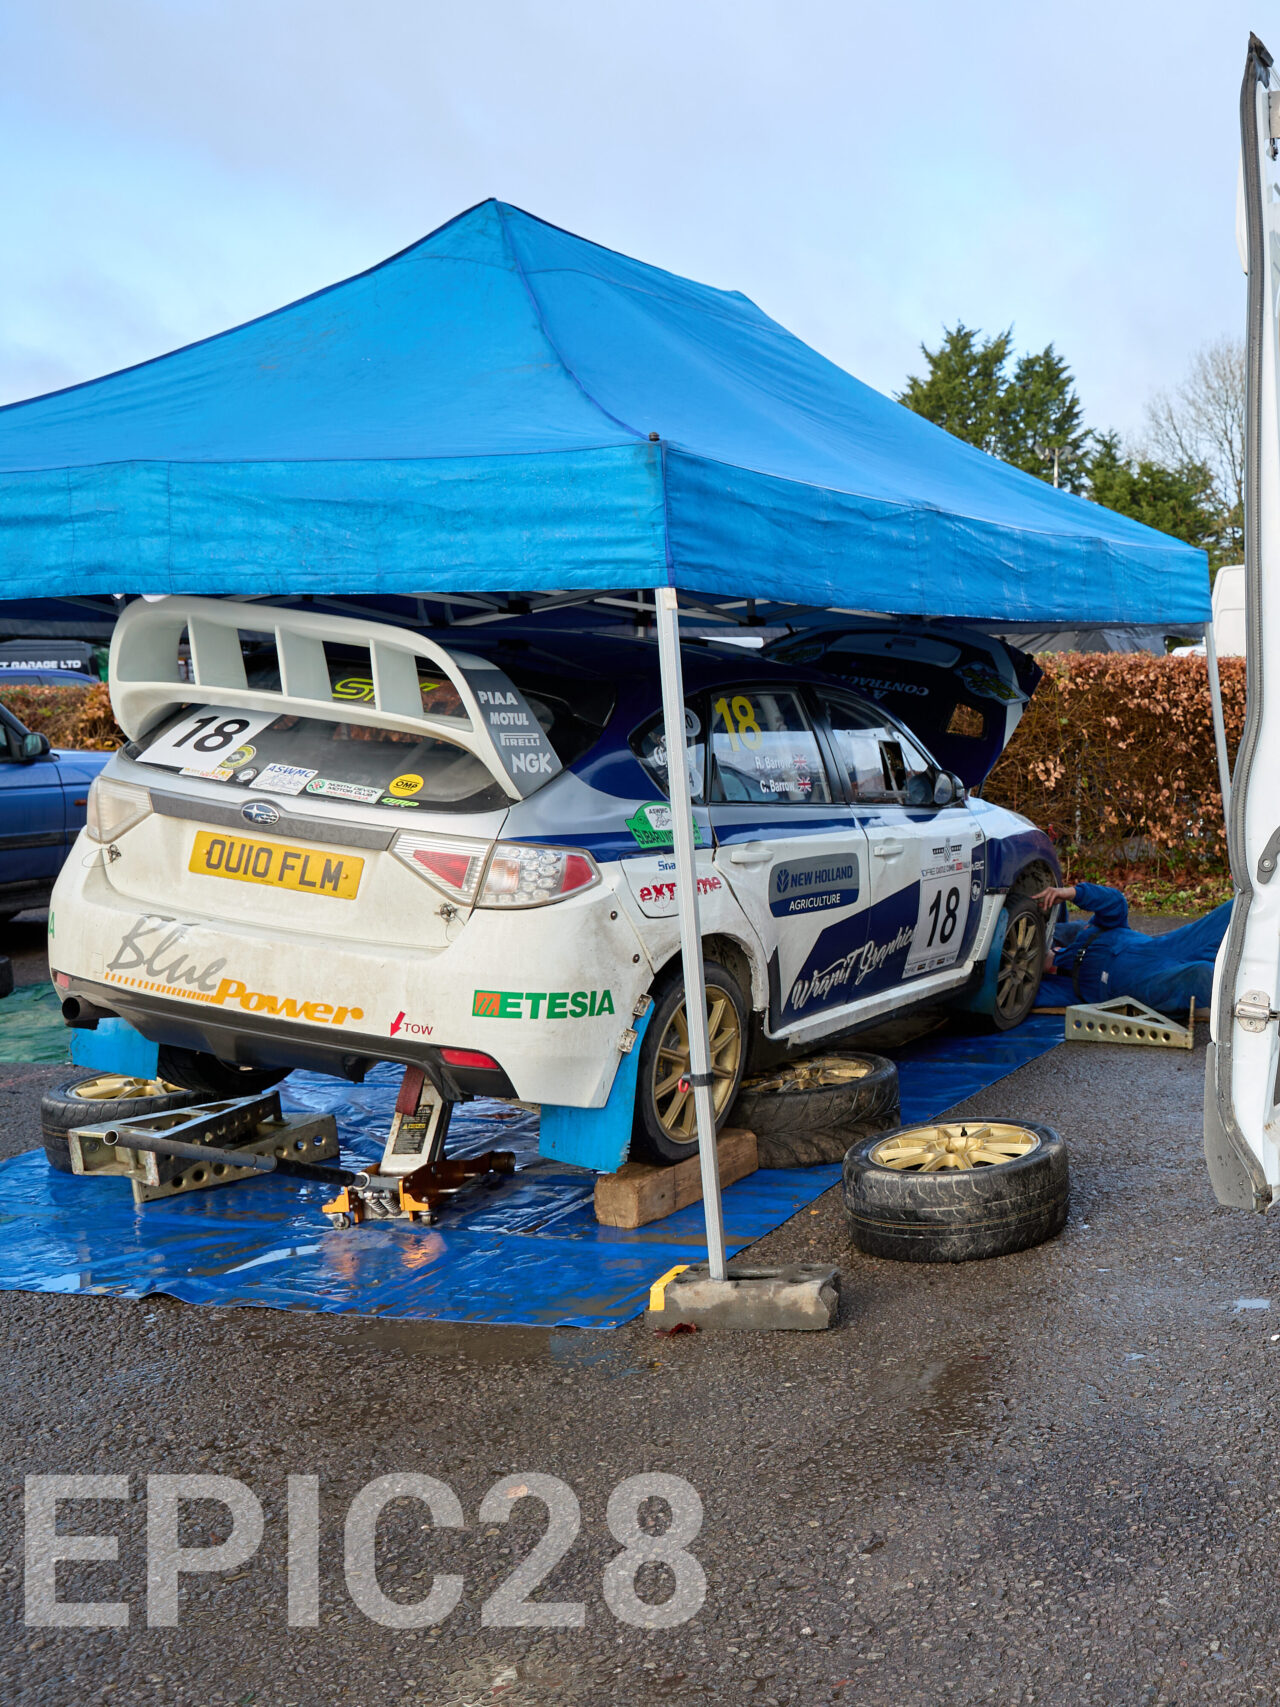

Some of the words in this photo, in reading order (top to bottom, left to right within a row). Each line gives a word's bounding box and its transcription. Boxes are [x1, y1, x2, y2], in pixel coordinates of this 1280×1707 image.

[10, 661, 58, 669] GARAGE
[60, 660, 82, 669] LTD
[477, 690, 519, 705] PIAA
[489, 711, 529, 726] MOTUL
[714, 696, 763, 752] 18
[172, 715, 250, 752] 18
[500, 733, 540, 746] PIRELLI
[267, 764, 315, 778] ASWMC
[511, 753, 552, 774] NGK
[326, 781, 351, 791] NORTH
[353, 786, 379, 795] DEVON
[326, 786, 352, 795] MOTOR
[354, 790, 374, 798] CLUB
[394, 780, 419, 790] OMP
[760, 779, 769, 793] C.
[770, 778, 796, 793] Barrow
[205, 838, 273, 879] OU10
[277, 851, 344, 892] FLM
[790, 871, 814, 888] NEW
[814, 865, 853, 884] HOLLAND
[789, 893, 841, 912] AGRICULTURE
[926, 886, 960, 948] 18
[106, 913, 228, 992] Blue
[211, 977, 364, 1025] Power
[500, 989, 616, 1020] ETESIA
[404, 1022, 434, 1036] TOW
